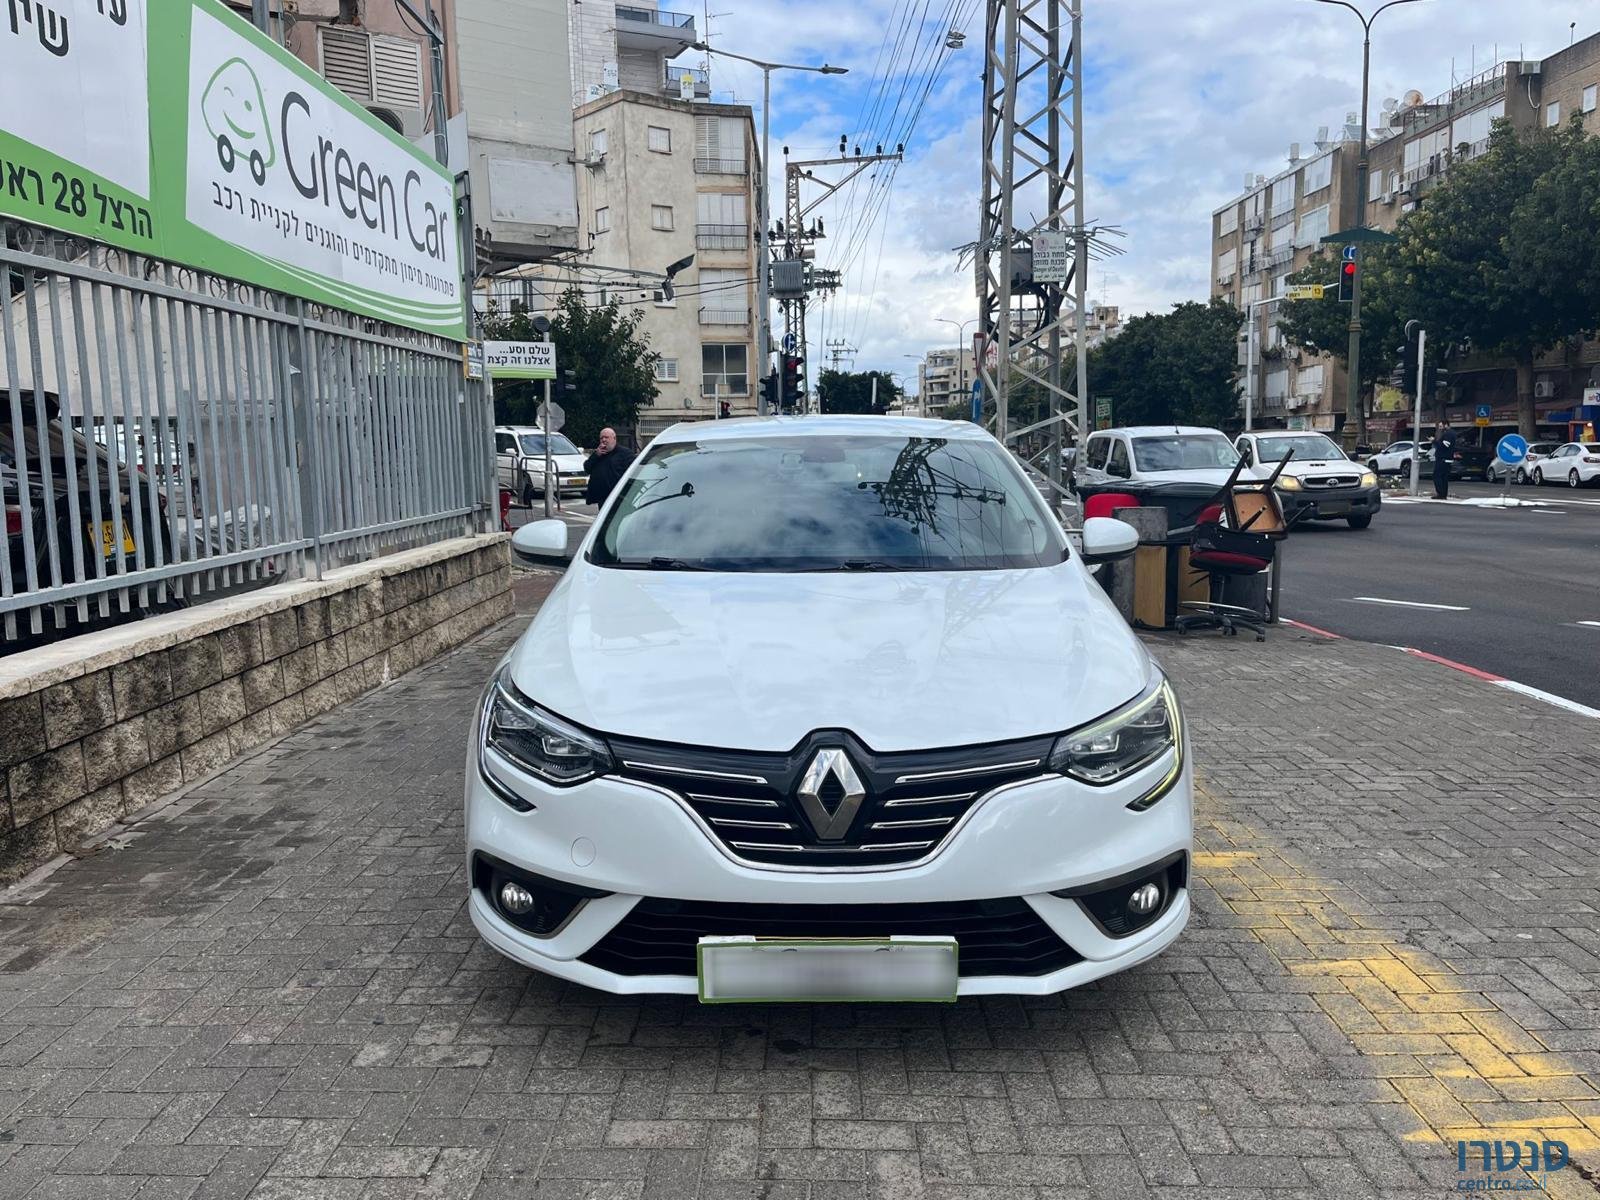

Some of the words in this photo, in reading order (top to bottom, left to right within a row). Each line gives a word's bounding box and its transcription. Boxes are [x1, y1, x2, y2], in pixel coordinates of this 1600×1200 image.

[0, 158, 45, 206] רא
[281, 91, 399, 241] Green
[404, 169, 448, 263] Car
[51, 171, 87, 218] 28
[92, 182, 153, 240] הרצל
[212, 181, 244, 215] רכב
[250, 197, 299, 238] לקניית
[305, 221, 349, 257] והוגנים
[352, 241, 398, 276] מתקדמים
[400, 261, 423, 284] מימון
[424, 272, 454, 297] פתרונות
[487, 355, 508, 366] קצת
[510, 356, 522, 364] זה
[524, 355, 551, 365] אצלנו
[528, 345, 550, 355] שלם
